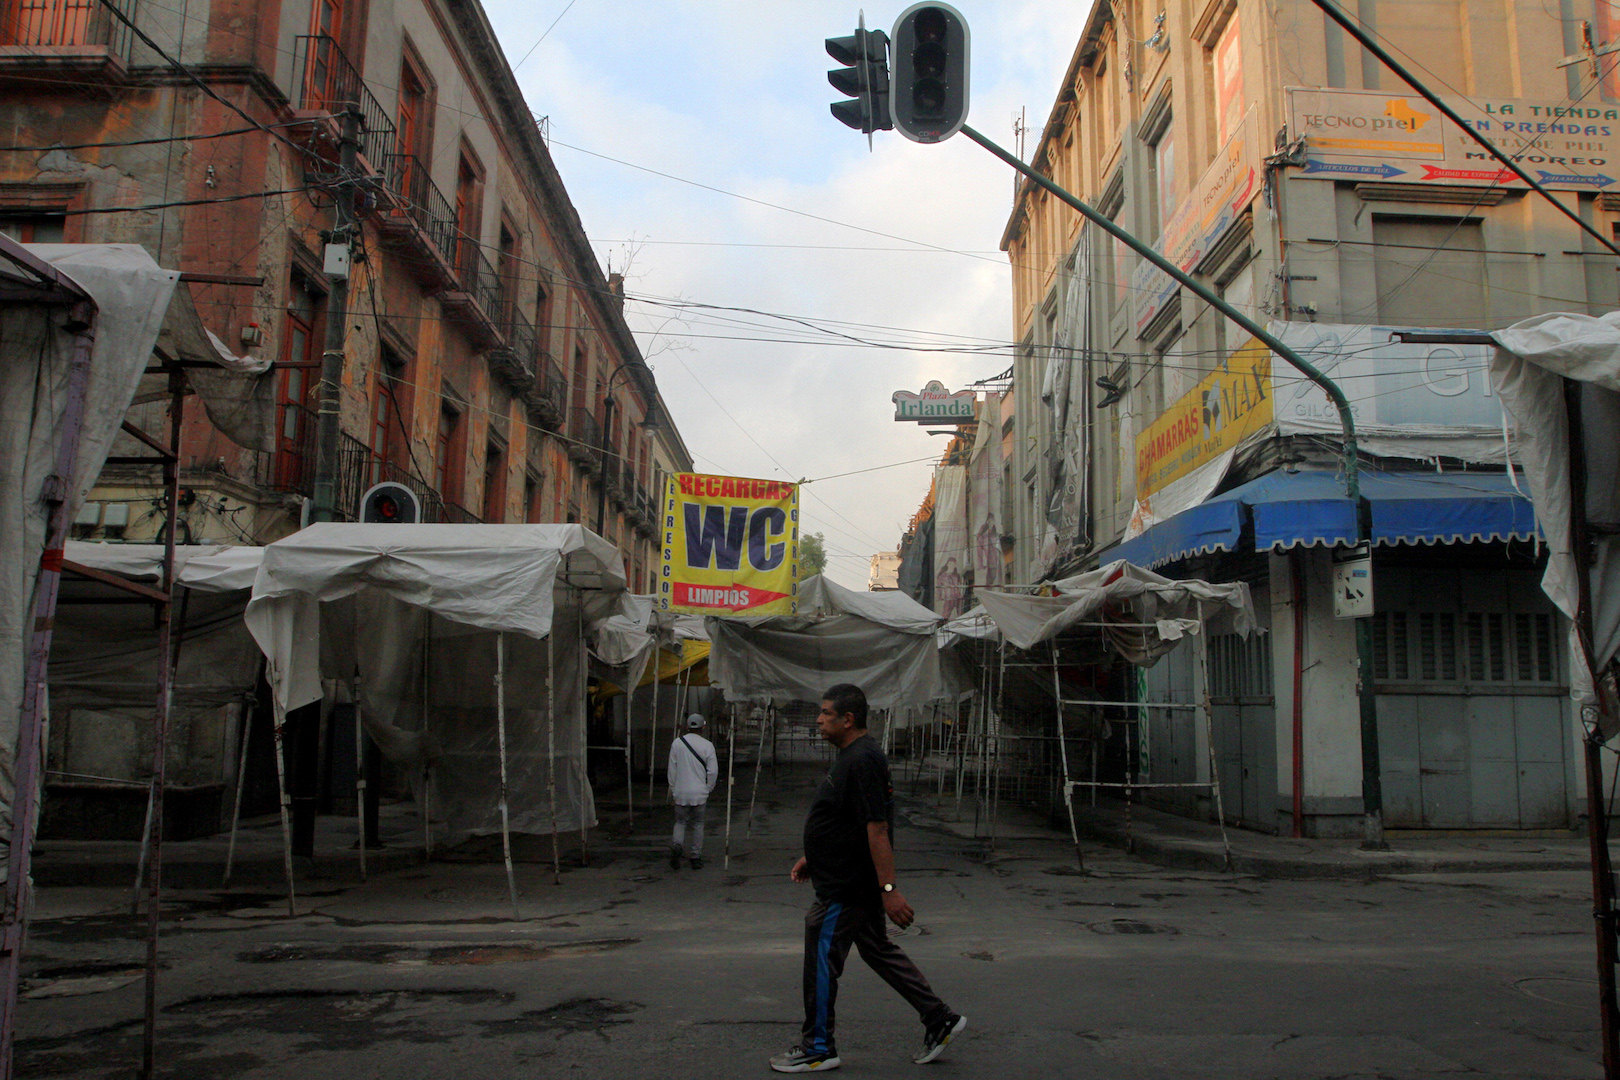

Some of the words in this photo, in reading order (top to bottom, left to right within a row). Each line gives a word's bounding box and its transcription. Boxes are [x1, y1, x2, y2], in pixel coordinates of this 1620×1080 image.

[1486, 103, 1514, 115] LA
[1529, 106, 1618, 120] TIENDA
[1303, 115, 1367, 128] TECNO
[1371, 112, 1415, 131] piel
[1503, 121, 1611, 136] PRENDAS
[1459, 136, 1523, 148] VNTA
[1566, 141, 1608, 151] PIEL
[1317, 163, 1358, 171] ARTICULOS
[1204, 176, 1224, 207] TECNO
[923, 392, 948, 400] Plaza
[900, 400, 971, 416] Irlanda
[1295, 404, 1360, 418] GILCR
[1139, 407, 1199, 472] CHAMARRAS
[679, 474, 794, 500] RECARGAS
[683, 502, 787, 572] WC
[688, 586, 749, 606] LIMPIOS
